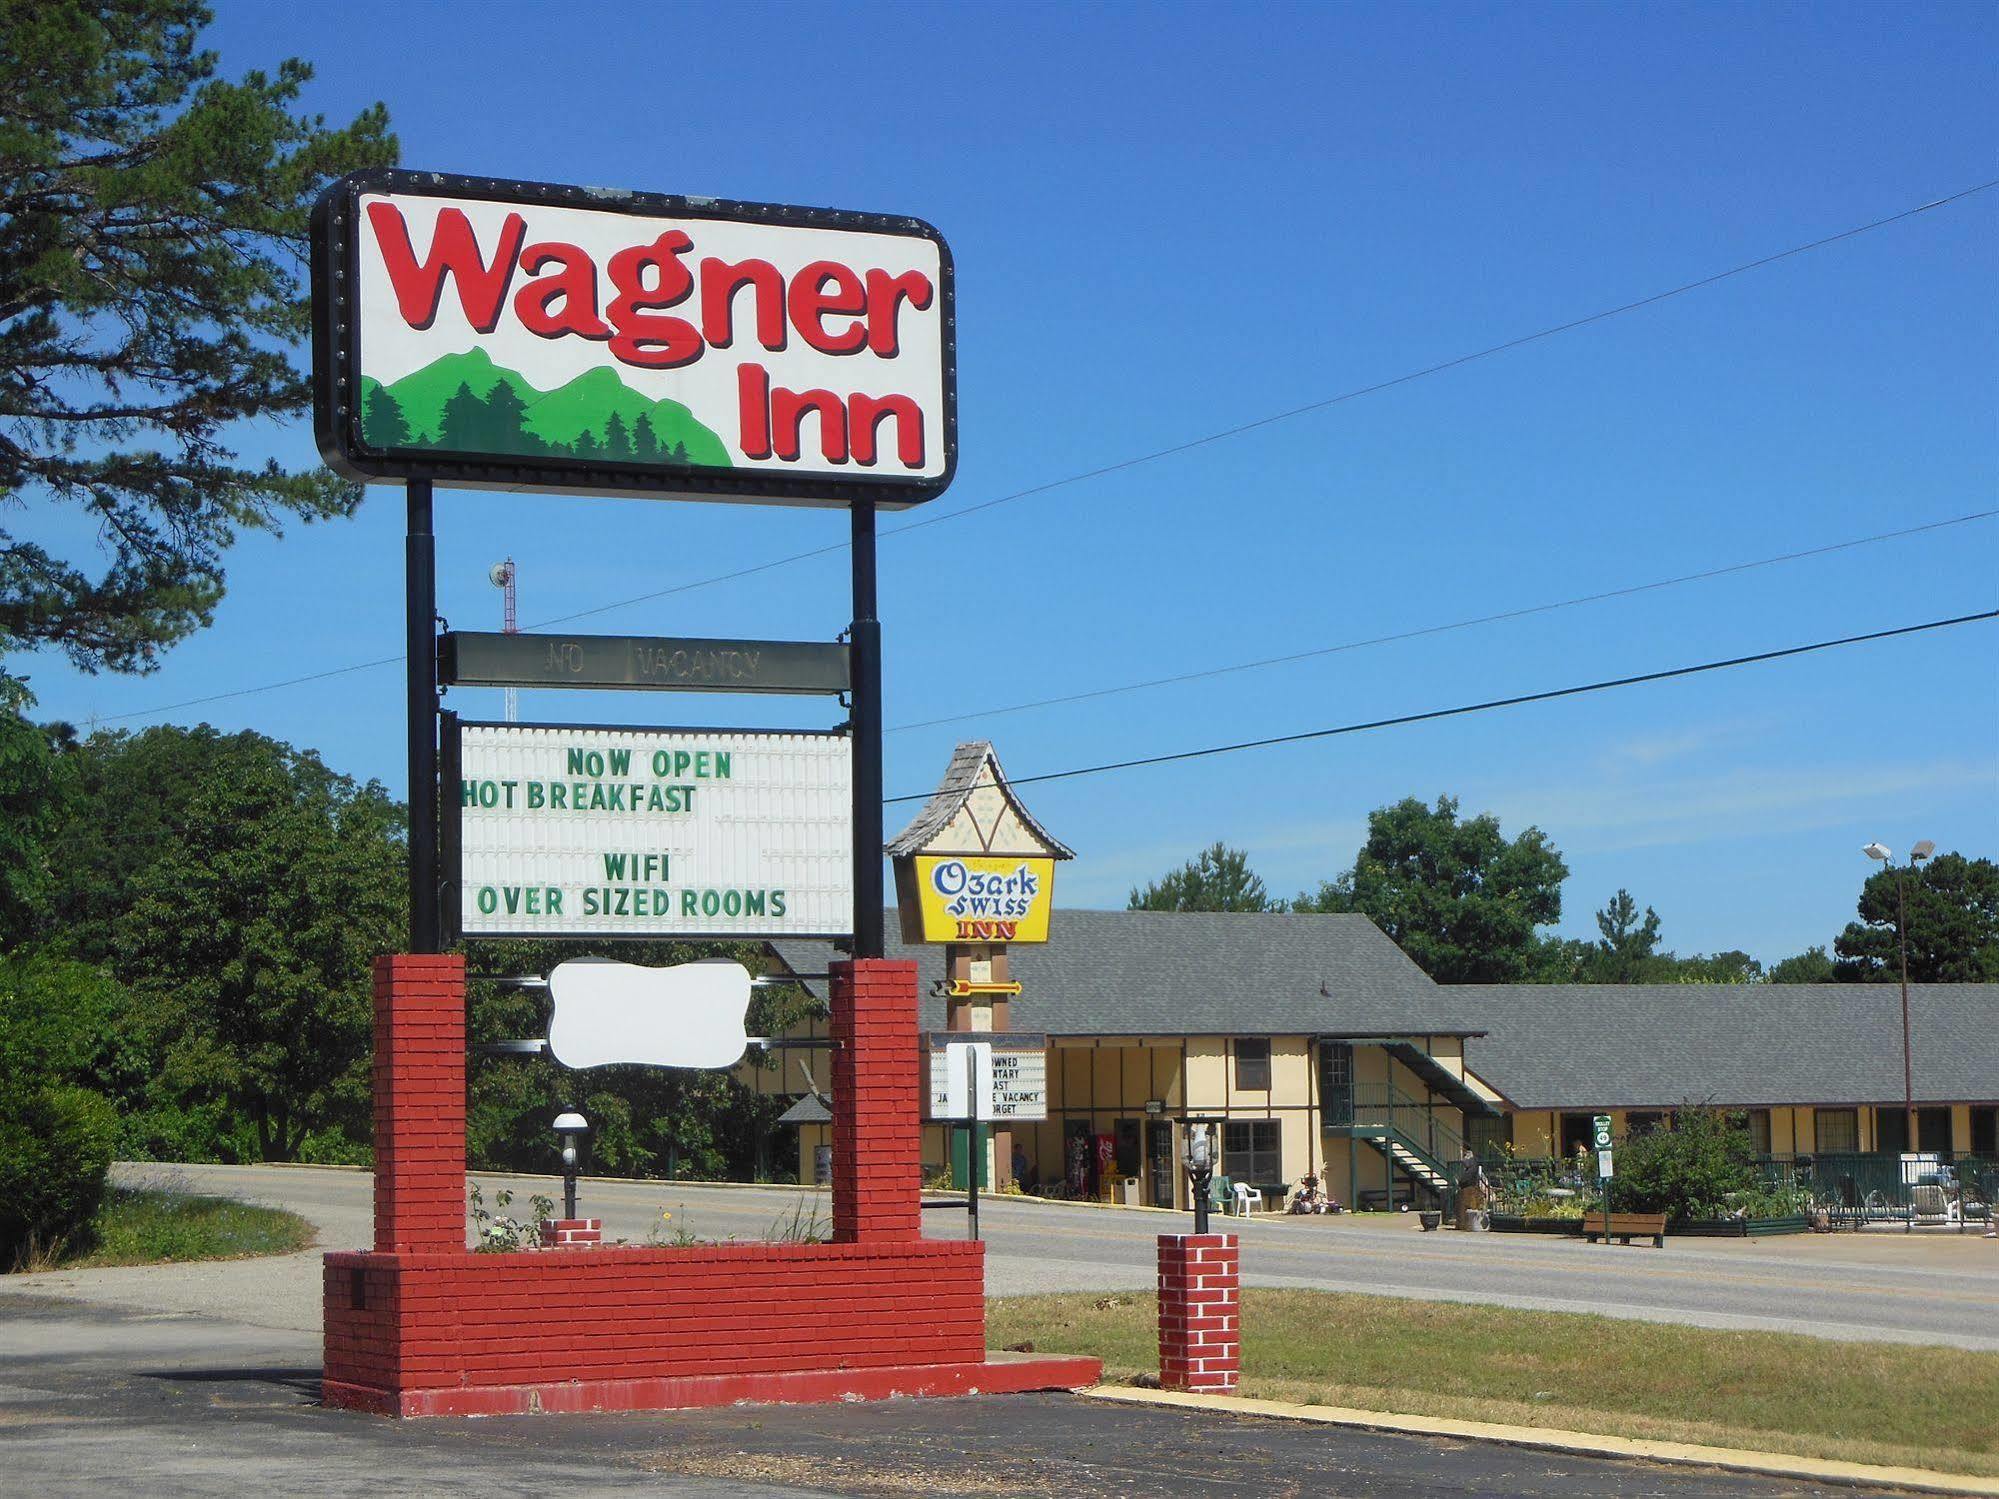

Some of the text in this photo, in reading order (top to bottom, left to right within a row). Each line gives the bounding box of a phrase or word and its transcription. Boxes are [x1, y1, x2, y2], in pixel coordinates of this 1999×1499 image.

[367, 201, 933, 369] Wagner
[737, 362, 924, 469] Inn
[546, 642, 760, 678] NO VACANCY
[567, 747, 731, 779] NOW OPEN
[462, 779, 697, 813] HOT BREAKFAST
[604, 853, 669, 882] WIFI
[934, 862, 1037, 896] Ozark
[477, 886, 787, 917] OVER SIZED ROOMS
[947, 895, 1029, 916] SWISS
[955, 920, 1018, 940] INN
[1002, 1092, 1039, 1102] VACANCY
